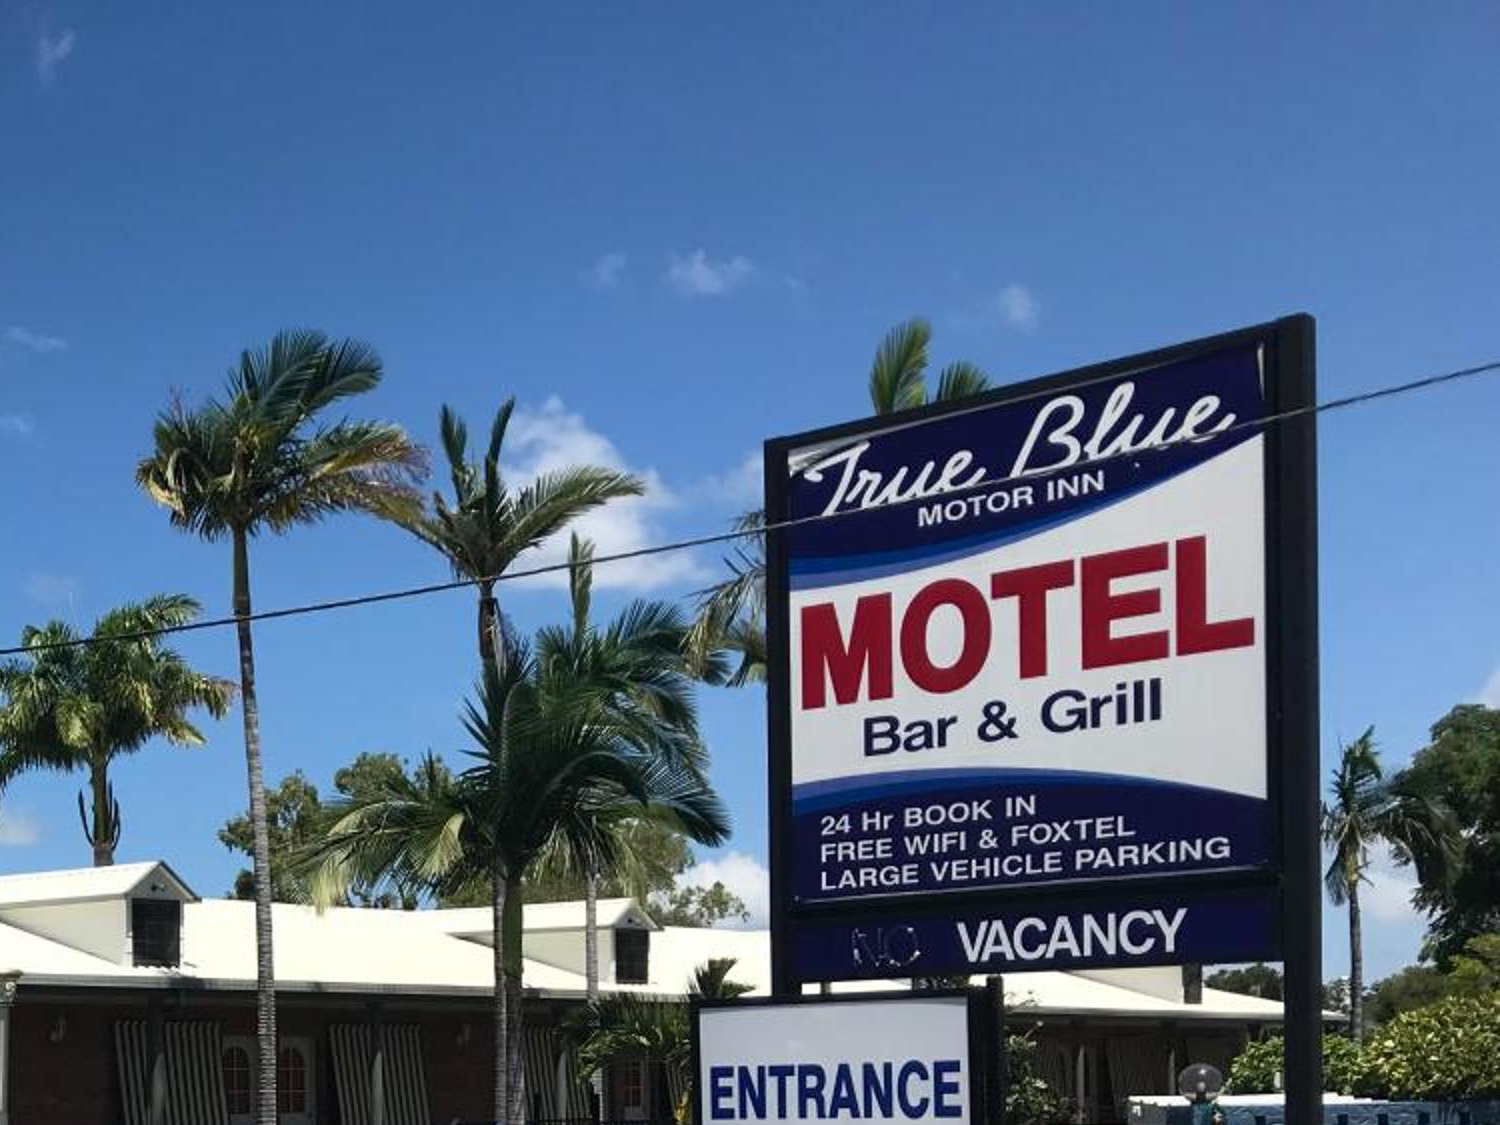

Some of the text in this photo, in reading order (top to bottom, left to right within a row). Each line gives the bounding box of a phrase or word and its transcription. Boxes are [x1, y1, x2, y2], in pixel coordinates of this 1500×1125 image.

[804, 381, 1237, 517] True Blue
[917, 470, 1104, 527] MOTOR INN
[801, 535, 1255, 710] MOTEL
[864, 677, 1162, 756] Bar & Grill
[820, 795, 1036, 836] 24 Hr BOOK IN
[820, 816, 1135, 863] FREE WIFI & FOXTEL
[820, 837, 1231, 890] LARGE VEHICLE PARKING
[957, 907, 1188, 963] VACANCY
[710, 1060, 963, 1120] ENTRANCE
